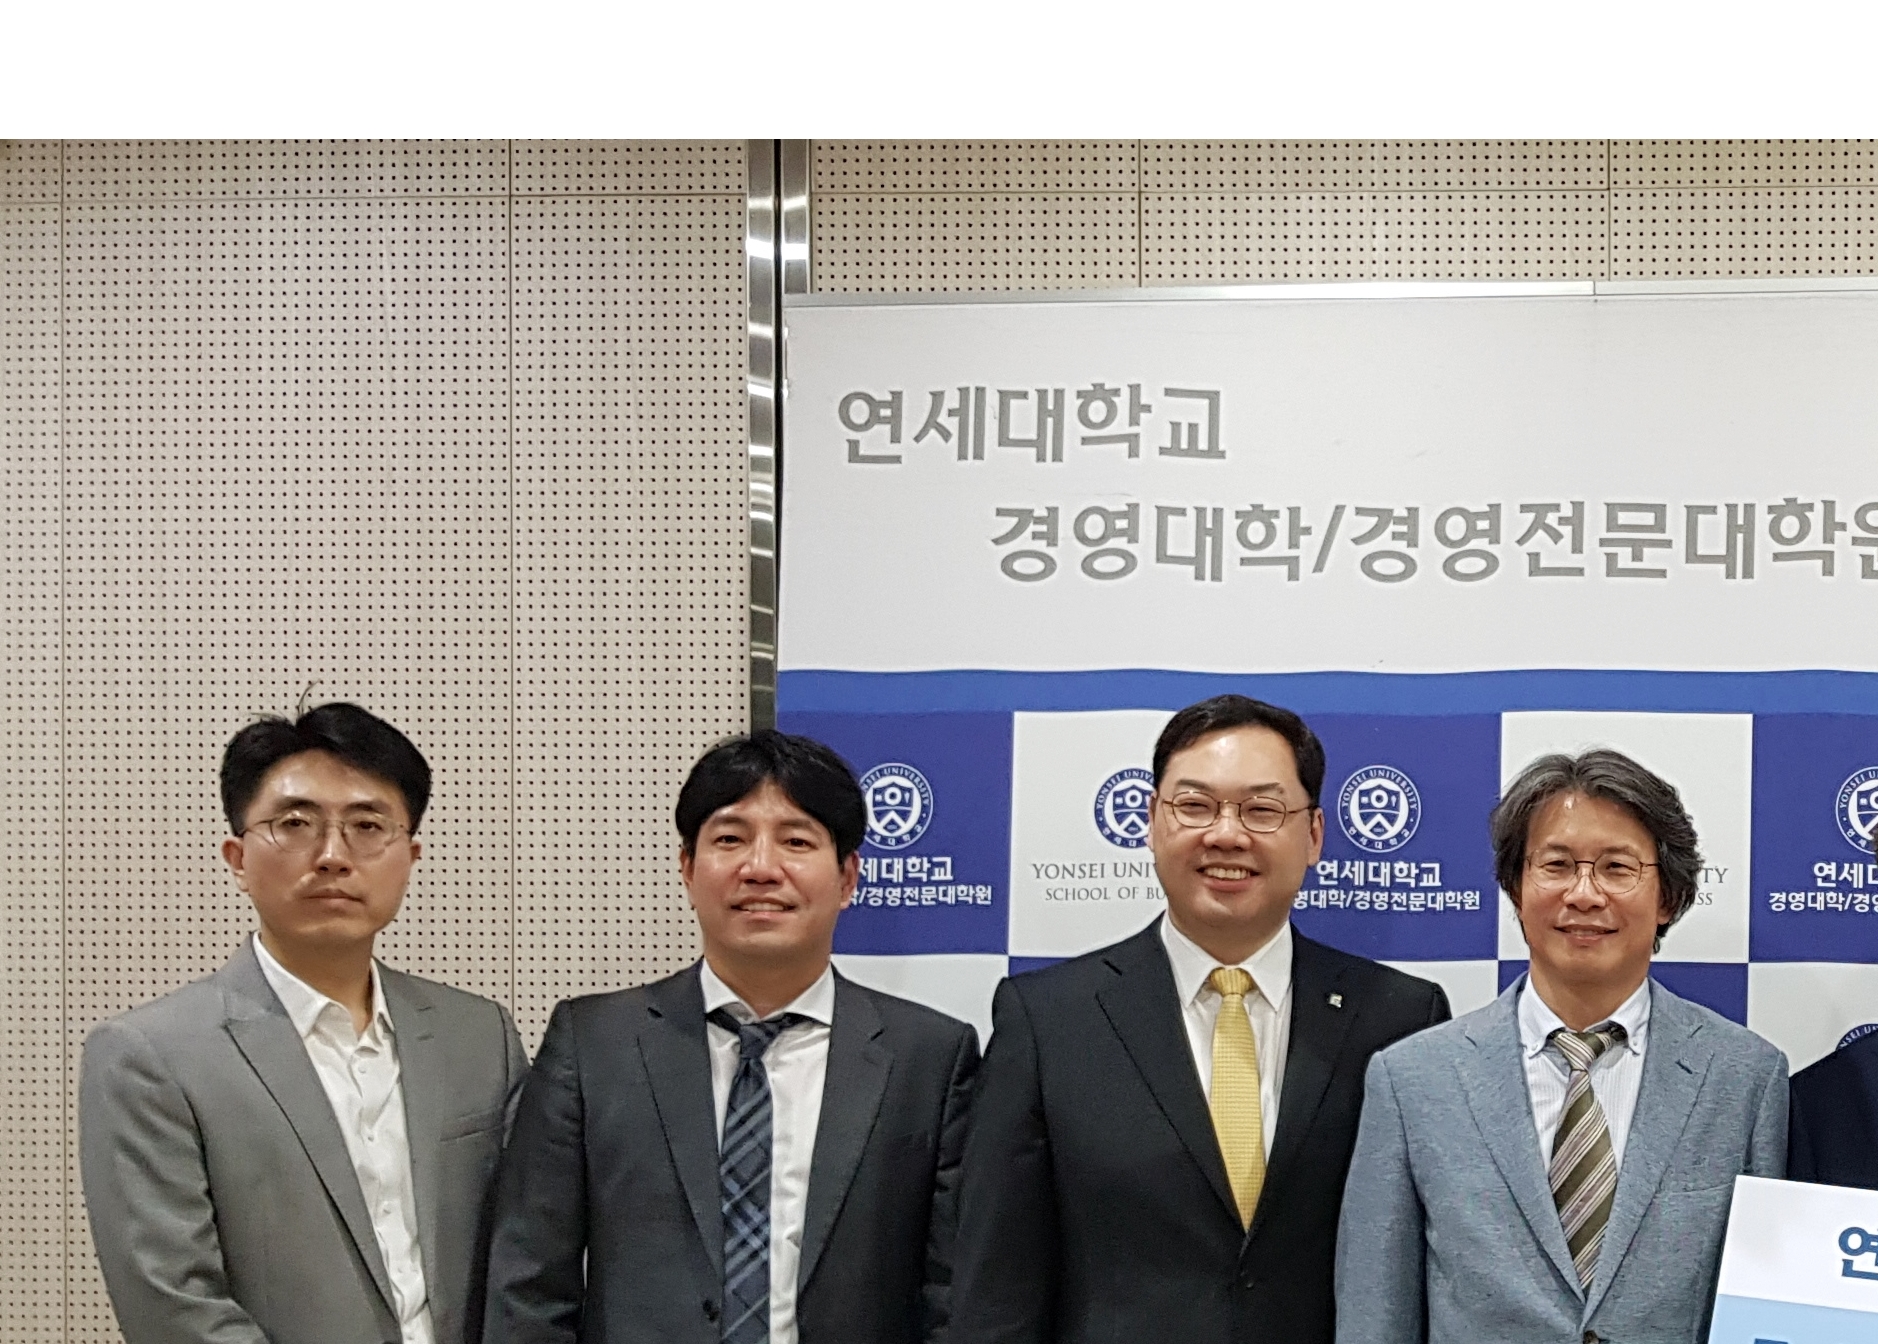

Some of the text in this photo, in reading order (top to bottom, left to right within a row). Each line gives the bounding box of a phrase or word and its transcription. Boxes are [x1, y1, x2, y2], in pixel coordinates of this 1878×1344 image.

[838, 383, 1226, 464] 연세대학교
[1341, 768, 1418, 811] YONSEI UNIVERSITY
[1838, 774, 1866, 809] YONSEI
[859, 856, 953, 883] 세대학교
[1032, 862, 1105, 880] YONSEI
[1316, 860, 1442, 888] 연세대학교
[1045, 887, 1111, 901] SCHOOL
[1117, 886, 1140, 900] OF
[1293, 889, 1480, 911] 영대학/경영전문대학원
